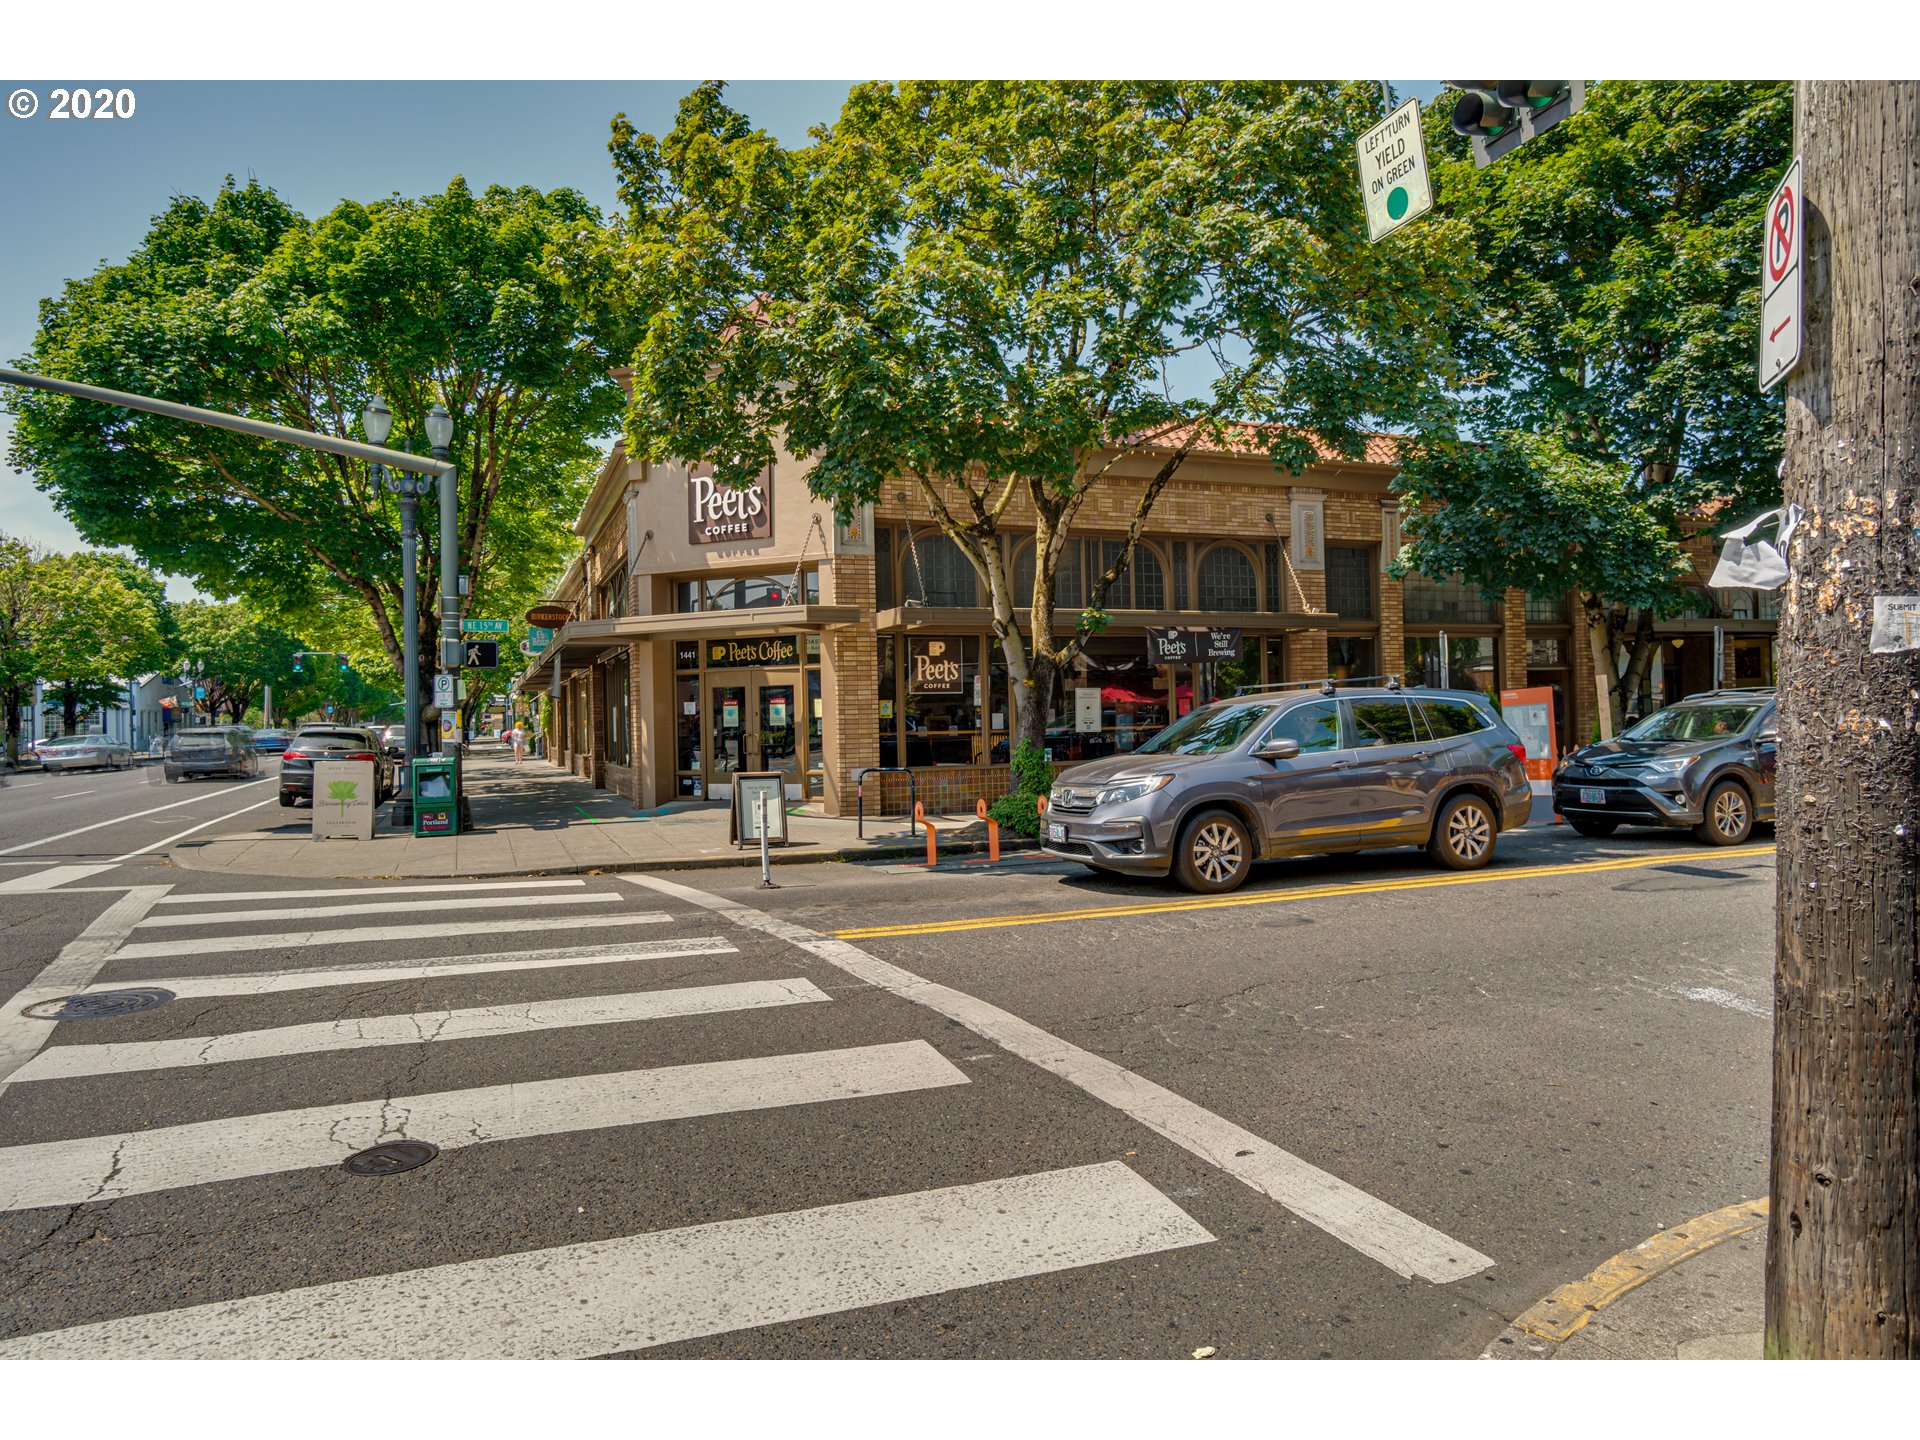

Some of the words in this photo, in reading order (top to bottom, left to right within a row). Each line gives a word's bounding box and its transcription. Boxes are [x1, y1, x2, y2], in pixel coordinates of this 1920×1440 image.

[1365, 130, 1385, 154] LEFT
[1387, 111, 1410, 138] TURN
[1375, 138, 1405, 170] YIELD
[1372, 177, 1384, 195] ON
[1387, 155, 1415, 185] GREEN
[705, 523, 748, 536] COFFEE
[1888, 603, 1916, 611] SUBMIT
[467, 621, 478, 631] NE
[494, 622, 503, 631] AV
[1210, 632, 1231, 640] We're
[1157, 638, 1187, 655] Peet's
[1213, 640, 1229, 648] Still
[679, 651, 696, 659] 1441
[728, 642, 757, 661] Peet's
[759, 640, 793, 661] Coffee
[1207, 648, 1236, 657] Brewing
[914, 655, 959, 682] Peet's
[423, 818, 449, 826] Portland
